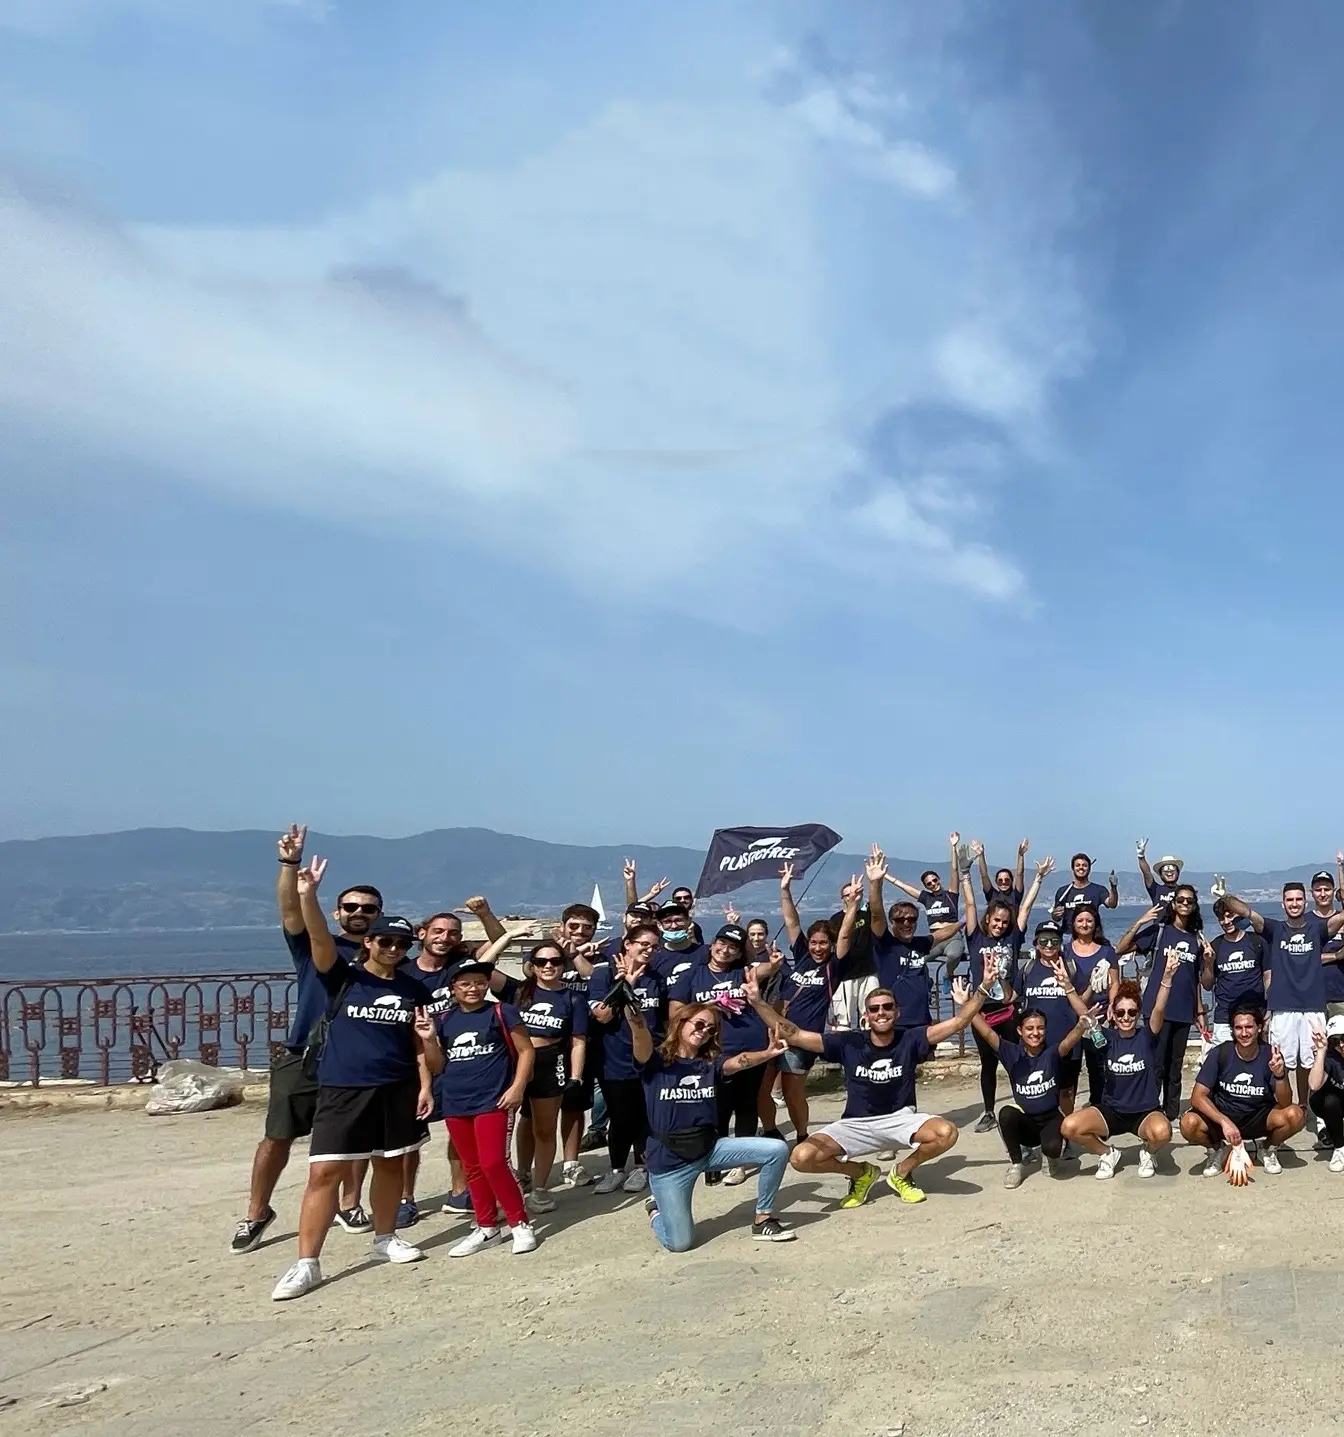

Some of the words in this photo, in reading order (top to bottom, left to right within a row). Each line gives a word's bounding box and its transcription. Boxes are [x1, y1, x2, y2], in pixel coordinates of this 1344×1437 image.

[720, 847, 800, 871] PLASTICFREE
[696, 988, 747, 1002] PLASTICFRE
[1026, 987, 1067, 997] PLASTICFRE
[347, 1005, 413, 1023] PLASTICFR
[520, 1011, 564, 1029] STICFREE
